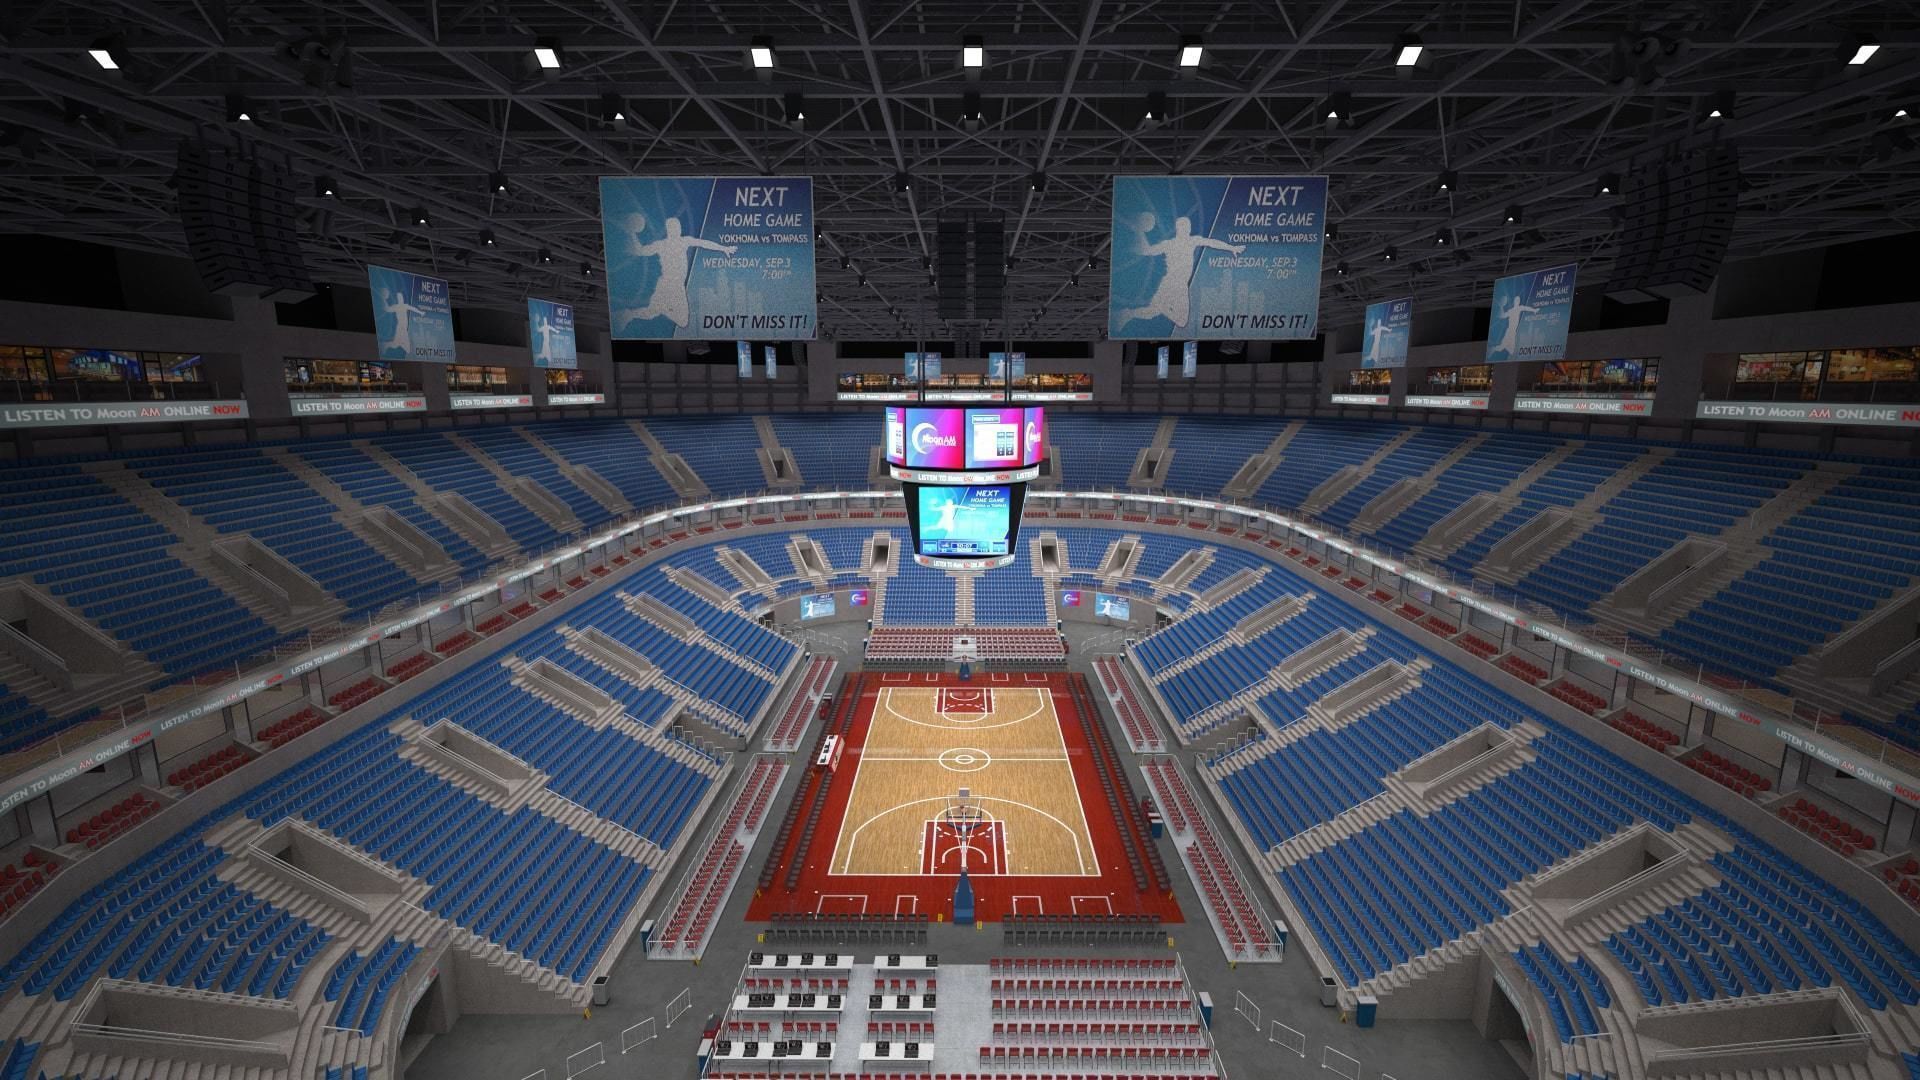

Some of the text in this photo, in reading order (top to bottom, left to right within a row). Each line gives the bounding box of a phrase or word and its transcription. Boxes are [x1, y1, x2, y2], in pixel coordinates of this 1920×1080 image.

[735, 187, 789, 207] NEXT
[1248, 186, 1304, 206] NEXT
[724, 214, 802, 227] HOME GAME
[1234, 213, 1315, 226] HOME GAME
[719, 234, 759, 243] YOKHOMA
[772, 234, 808, 243] TOMPASS
[1228, 234, 1269, 242] YOKHOMA
[1282, 234, 1318, 242] TOMPASS
[1542, 272, 1566, 286] NEXT
[422, 281, 440, 294] NEXT
[1536, 286, 1569, 298] HOME GAME
[419, 295, 432, 303] HOME
[703, 315, 807, 329] DON'T MISS IT!
[1202, 314, 1308, 328] DON'T MISS IT!
[416, 348, 432, 356] DON'T
[1520, 345, 1536, 355] DON'T
[297, 403, 328, 411] LISTEN
[379, 401, 405, 409] ONLINE
[1518, 401, 1540, 409] LISTEN
[1575, 402, 1587, 410] AM
[1589, 403, 1621, 411] ONLINE
[1622, 403, 1645, 411] NOW
[1704, 405, 1745, 415] LISTEN
[1748, 407, 1765, 416] TO
[1769, 407, 1804, 418] Moon
[1808, 408, 1831, 418] AM
[1836, 409, 1897, 421] ONLINE
[4, 405, 240, 422] LISTEN TO Moon AM ONLINE NOW
[1532, 626, 1550, 637] LISTEN
[1551, 632, 1558, 640] TO
[1583, 647, 1605, 660] ONLINE
[292, 662, 312, 674] LISTEN
[314, 657, 322, 665] TO
[1630, 666, 1655, 681] LISTEN
[1656, 677, 1666, 686] TO
[1668, 683, 1689, 696] Moon
[1690, 693, 1702, 702] AM
[1705, 698, 1737, 717] ONLINE
[161, 713, 188, 730] LISTEN
[190, 708, 201, 717] TO
[203, 699, 225, 712] Moon
[226, 694, 237, 702] AM
[239, 680, 266, 697] ONLINE
[1776, 728, 1802, 746] LISTEN
[1804, 741, 1815, 752] TO
[1816, 749, 1840, 765] Moon
[1841, 761, 1856, 772] AM
[1857, 768, 1893, 789] ONLINE
[30, 781, 46, 793] TO
[49, 767, 77, 785] Moon
[79, 758, 94, 770] AM
[95, 740, 129, 762] ONLINE
